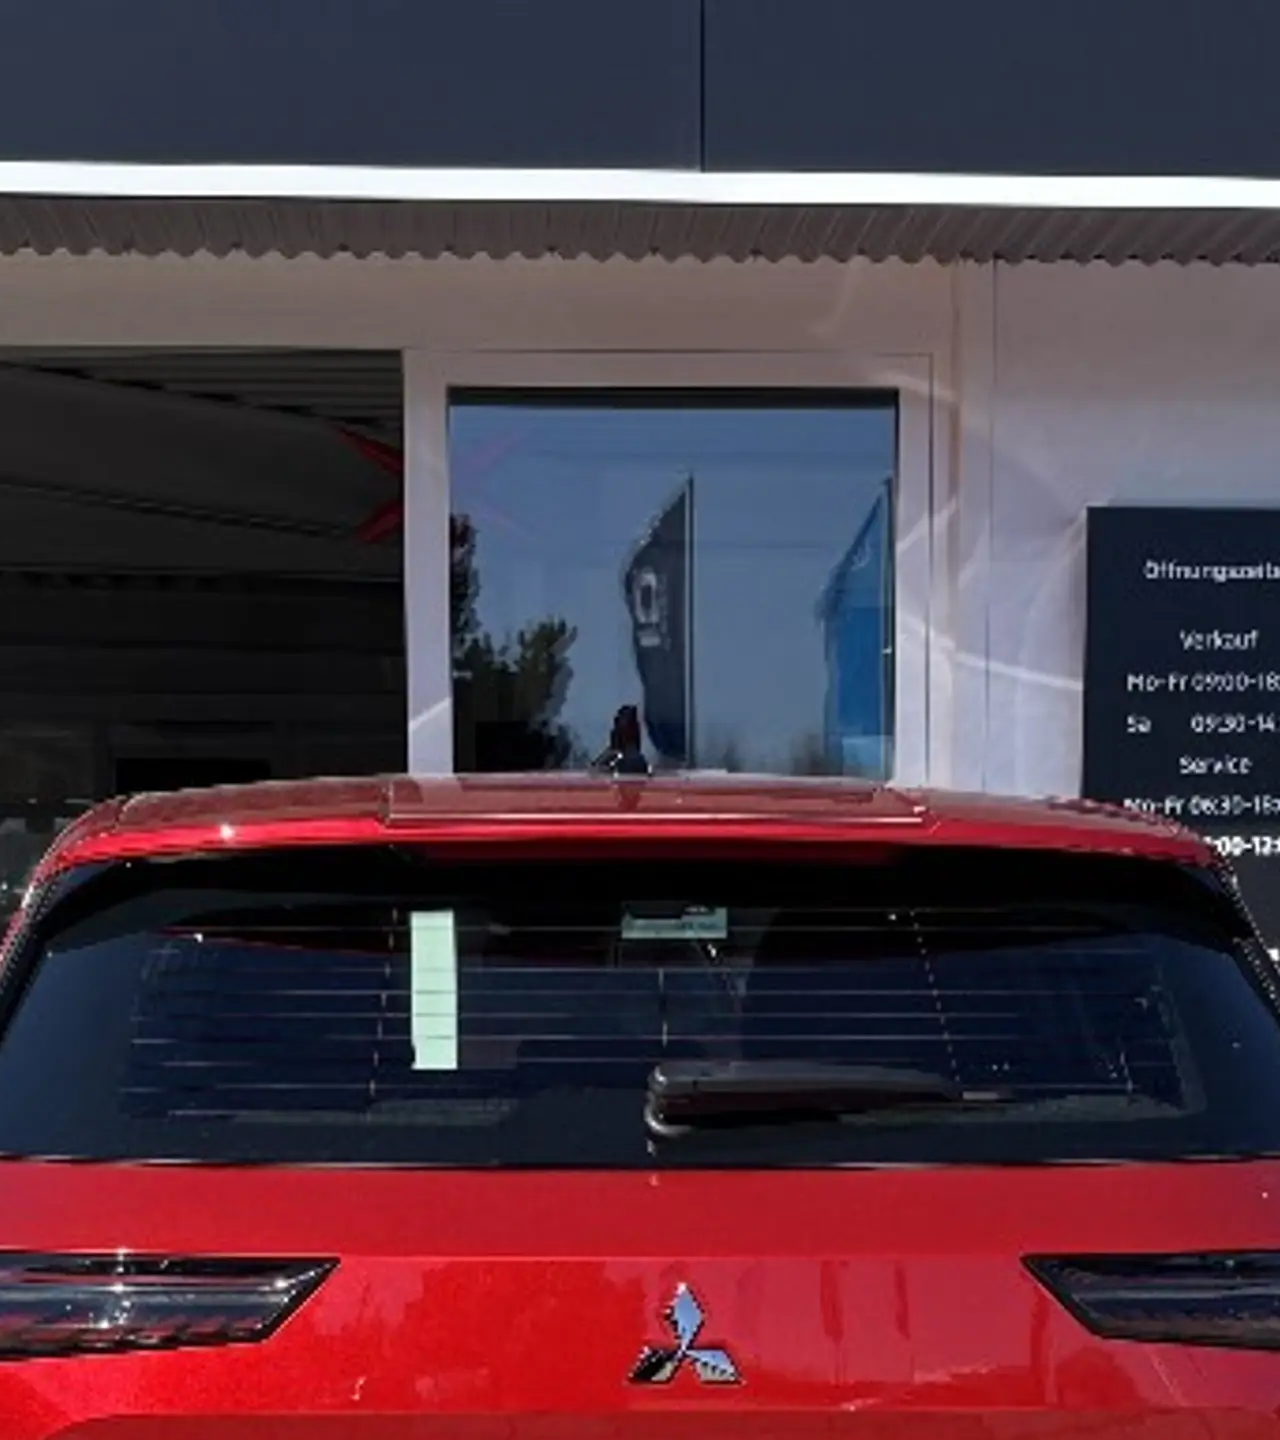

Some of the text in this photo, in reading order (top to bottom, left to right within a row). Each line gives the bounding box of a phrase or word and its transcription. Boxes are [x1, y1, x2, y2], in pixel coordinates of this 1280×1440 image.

[1179, 628, 1259, 651] Verkauf
[1126, 672, 1189, 693] Mo-Fr
[1126, 714, 1152, 734] Sa
[1178, 755, 1251, 775] Service
